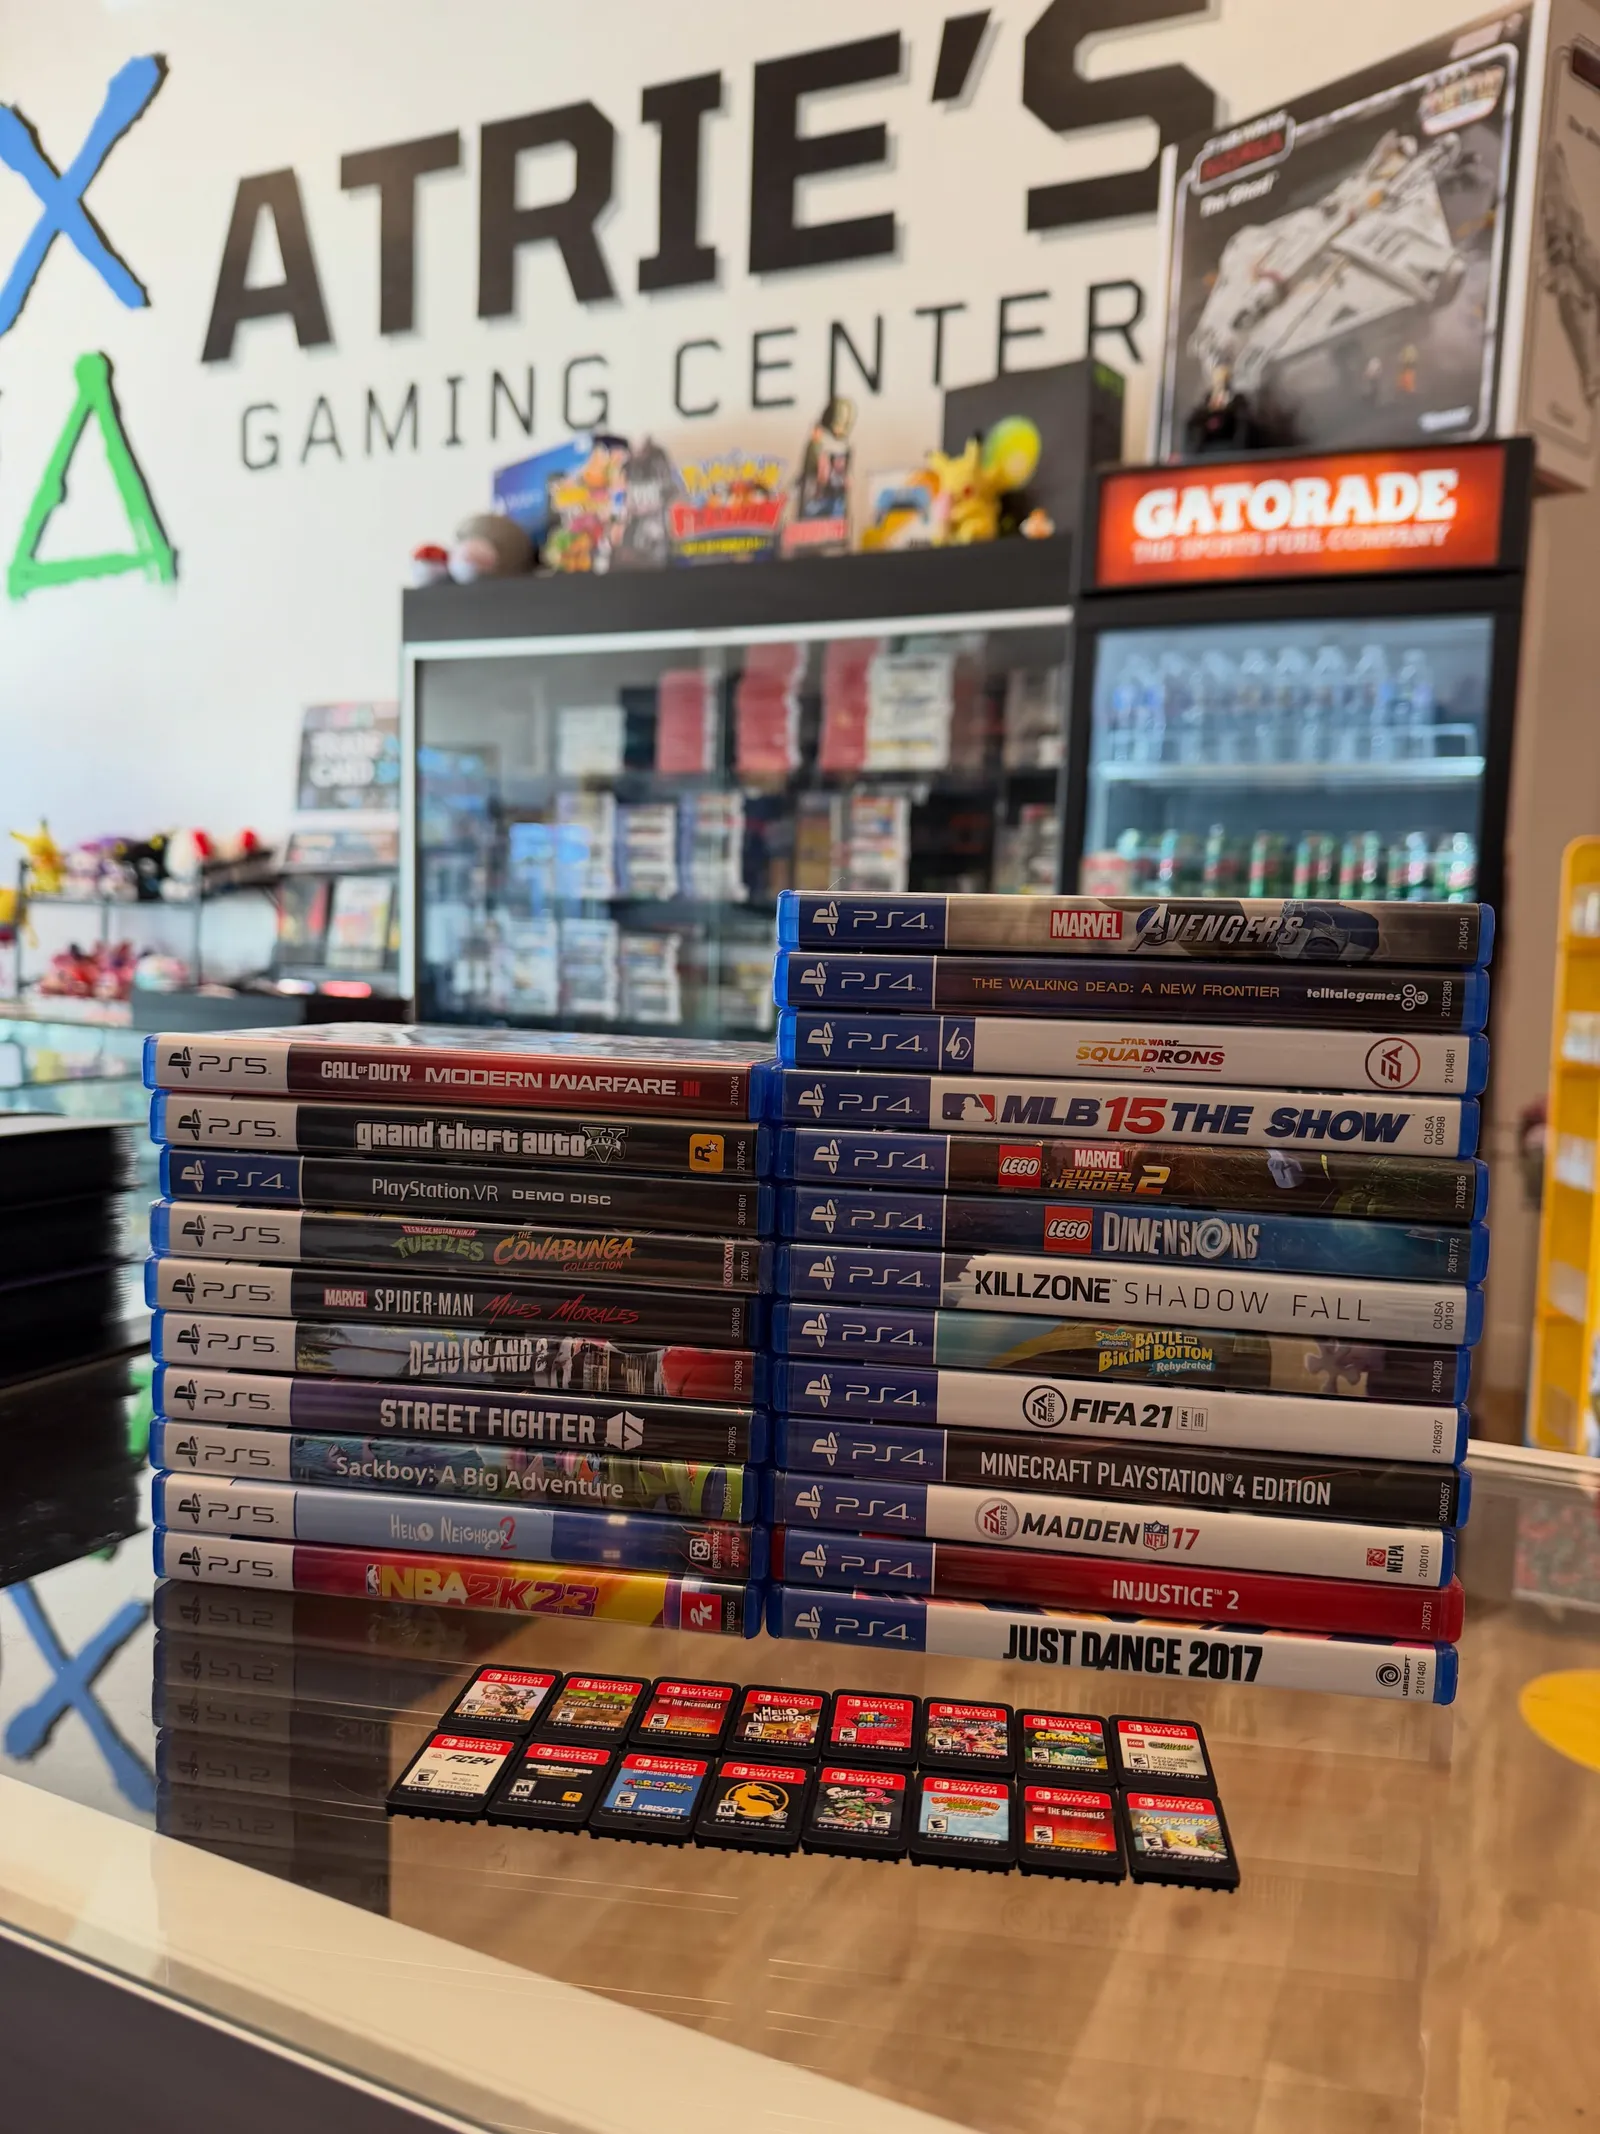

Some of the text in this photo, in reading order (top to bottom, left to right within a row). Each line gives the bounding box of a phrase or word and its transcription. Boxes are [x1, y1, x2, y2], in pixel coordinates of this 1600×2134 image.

[200, 0, 1219, 363] ATRIE'S
[240, 279, 1146, 471] GAMING CENTER
[1133, 469, 1459, 539] GATORADE
[853, 910, 929, 929] PS4
[1052, 904, 1303, 950] MARVEL AVENGERS
[1458, 916, 1470, 951] 2104541
[840, 971, 916, 991] PS4
[972, 977, 1280, 998] THE WALKING DEAD: A NEW FRONTIER
[1306, 987, 1401, 1002] telltalegames
[1441, 980, 1453, 1017] 2102389
[847, 1032, 923, 1051] PS4
[1075, 1046, 1225, 1065] SQUADRONS
[1120, 1037, 1180, 1046] STAR WARS
[198, 1054, 268, 1075] PS5
[1380, 1045, 1403, 1082] EA
[1444, 1048, 1456, 1084] 2104881
[321, 1061, 359, 1081] CALL
[358, 1065, 369, 1074] OF
[368, 1063, 412, 1082] DUTY
[425, 1067, 542, 1088] MODERN
[550, 1074, 677, 1096] WARFARE
[730, 1075, 740, 1106] 2110424
[838, 1093, 913, 1114] PS4
[208, 1117, 277, 1138] PS5
[1000, 1095, 1412, 1143] MLB 15 THE SHOW
[1423, 1115, 1434, 1145] CUSA
[1435, 1115, 1446, 1146] 00998
[356, 1120, 586, 1158] grand theft auto
[736, 1140, 746, 1171] 2107546
[854, 1149, 929, 1171] PS4
[1000, 1149, 1122, 1176] LEGO MARVEL
[216, 1168, 285, 1189] PS4
[1050, 1165, 1171, 1194] HEROES 2
[1060, 1168, 1132, 1182] SUPER
[372, 1178, 611, 1206] PlayStation VR DEMO DISC
[1455, 1174, 1467, 1210] 2102836
[737, 1193, 747, 1226] 3001601
[851, 1209, 926, 1230] PS4
[212, 1224, 281, 1244] PS5
[403, 1225, 433, 1234] TEENAGE
[517, 1230, 532, 1239] THE
[1046, 1211, 1259, 1260] LEGO DIMENSIONS
[390, 1234, 637, 1265] TURTLES COWABUNGA
[563, 1260, 623, 1272] COLLECTION
[723, 1242, 734, 1287] KONAMI
[740, 1251, 750, 1281] 2107670
[849, 1266, 924, 1288] PS4
[202, 1281, 272, 1302] PS5
[324, 1288, 640, 1324] MARVEL SPIDER-MAN MILES MORALES
[974, 1269, 1370, 1322] KILLZONE SHADOW FALL
[731, 1307, 741, 1339] 3006168
[1432, 1300, 1443, 1330] CUSA
[1444, 1301, 1455, 1331] 00190
[207, 1332, 276, 1353] PS5
[842, 1323, 917, 1345] PS4
[1135, 1331, 1182, 1348] BATTLE
[409, 1337, 532, 1376] DEAD ISLAND
[1098, 1344, 1213, 1373] BIKINI BOTTOM
[1156, 1360, 1212, 1372] Rehydrated
[733, 1360, 743, 1391] 2109298
[1431, 1359, 1444, 1393] 2104828
[204, 1388, 271, 1410] PS5
[845, 1384, 920, 1406] PS4
[1047, 1392, 1056, 1423] SPORTS
[380, 1399, 596, 1444] STREET FIGHTER
[1070, 1398, 1137, 1426] FIFA
[1140, 1403, 1173, 1429] 21
[1432, 1419, 1444, 1454] 2105937
[204, 1445, 272, 1467] PS5
[852, 1442, 927, 1465] PS4
[336, 1456, 625, 1499] Sackboy: A Big Adventure
[981, 1451, 1092, 1483] MINECRAFT
[1252, 1476, 1331, 1505] EDITION
[208, 1502, 276, 1523] PS5
[835, 1496, 909, 1520] PS4
[1438, 1481, 1451, 1522] 3000557
[390, 1513, 434, 1541] HELLO
[499, 1515, 517, 1551] 2
[1000, 1504, 1008, 1536] SPORTS
[1021, 1512, 1200, 1550] MADDEN NFL 17
[208, 1556, 273, 1577] PS5
[730, 1536, 740, 1568] 2109470
[1386, 1544, 1405, 1574] NFLPA
[1418, 1544, 1430, 1578] 2100101
[840, 1555, 915, 1579] PS4
[381, 1564, 599, 1617] NBA 2K23
[1112, 1579, 1239, 1610] INJUSTICE 2
[690, 1600, 713, 1627] 2K
[1421, 1601, 1432, 1631] 2105731
[835, 1617, 909, 1640] PS4
[1002, 1623, 1263, 1683] JUST DANCE 2017
[1402, 1654, 1412, 1696] UBISOFT
[1416, 1661, 1427, 1695] 2101480
[683, 1700, 721, 1709] INCREDIBLES
[753, 1712, 811, 1723] NEIGHBOR
[762, 1706, 799, 1716] HELLO
[862, 1702, 904, 1711] SWITCH
[456, 1742, 501, 1752] SWITCH
[552, 1752, 597, 1761] SWITCH
[847, 1776, 894, 1786] SWITCH
[638, 1804, 685, 1814] UBISOFT
[1047, 1806, 1105, 1819] THE INCREDIBLES
[1139, 1816, 1212, 1825] KART RACERS
